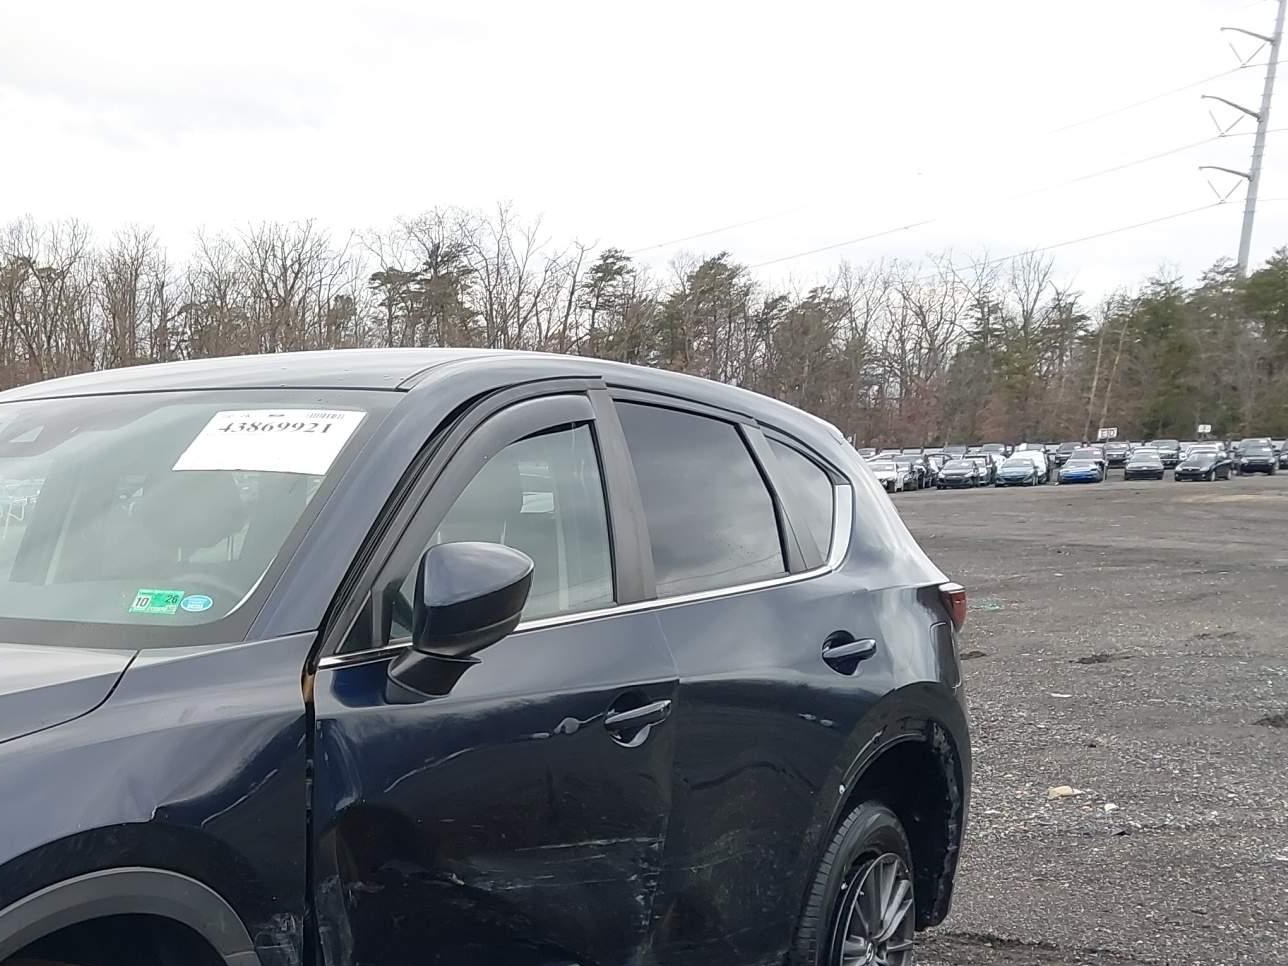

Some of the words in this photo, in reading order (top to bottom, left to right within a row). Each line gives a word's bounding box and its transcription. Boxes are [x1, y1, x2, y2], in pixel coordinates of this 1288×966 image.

[218, 421, 333, 434] 43869921
[135, 597, 149, 608] 10
[165, 594, 180, 604] 26
